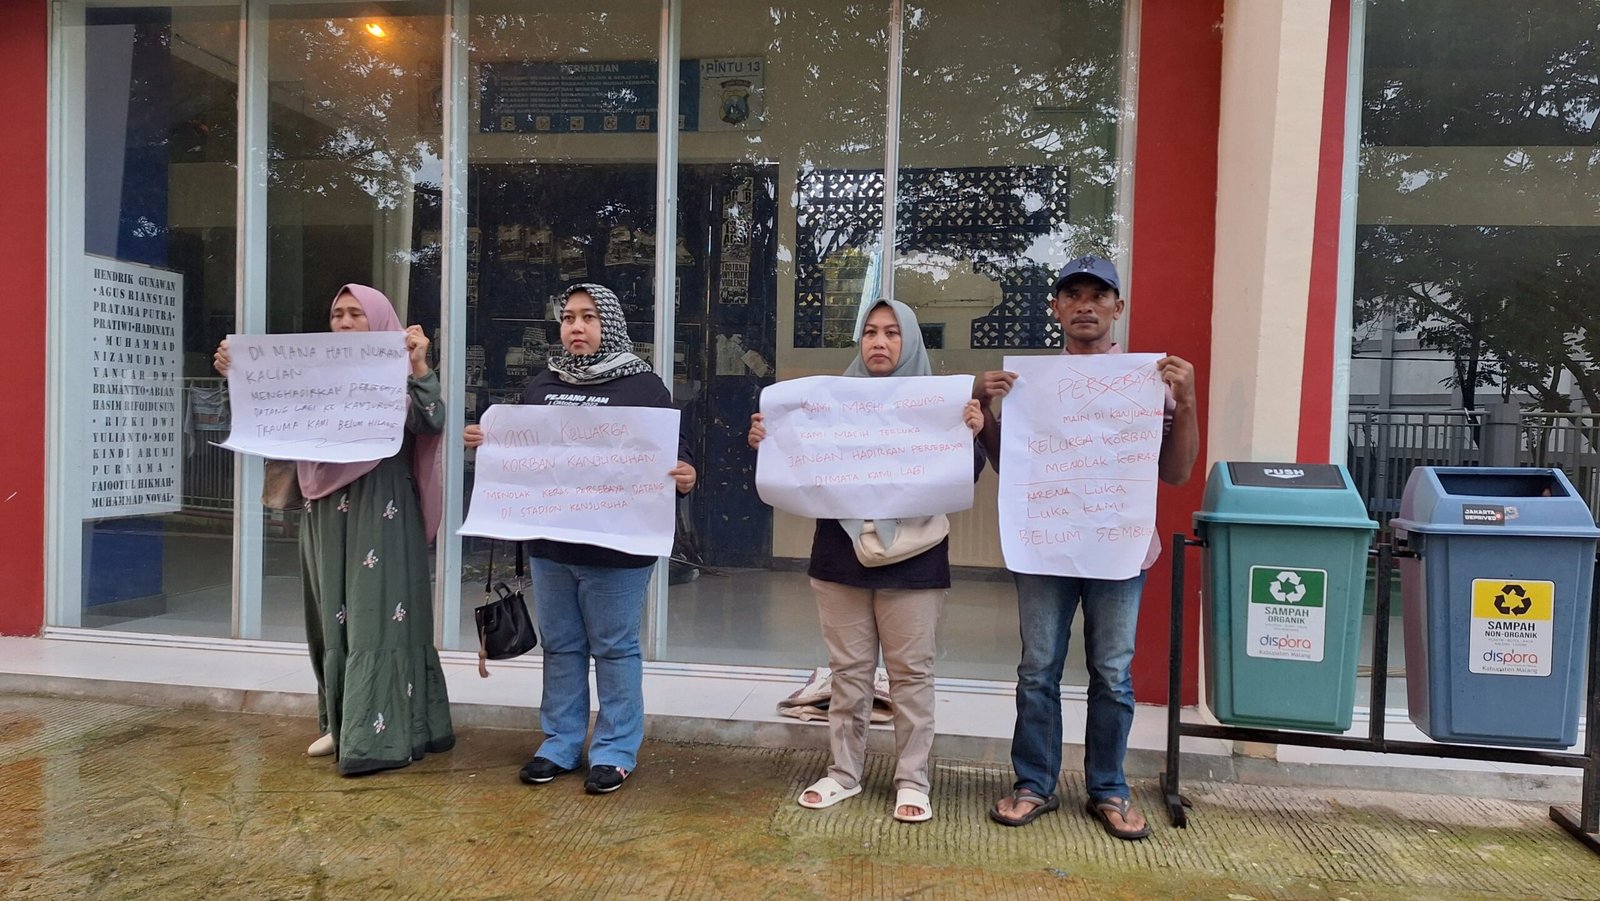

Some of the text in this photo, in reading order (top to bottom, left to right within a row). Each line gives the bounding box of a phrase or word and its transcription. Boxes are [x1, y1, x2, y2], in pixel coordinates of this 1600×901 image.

[560, 64, 619, 73] PERHATIAN
[706, 60, 760, 73] PINTU 13
[94, 268, 175, 291] HENDRIK GUNAWAN
[128, 290, 175, 306] RIANSYAH
[93, 301, 140, 317] PRATAMA
[105, 335, 175, 352] MUHAMMAD
[93, 351, 165, 365] NIZAMUDIN
[249, 346, 262, 361] DI
[273, 345, 316, 360] MANA
[326, 345, 352, 359] HATI
[93, 367, 174, 381] YANUAR DWI
[245, 369, 302, 382] KALIAN
[251, 387, 342, 401] MENGHADIRKAN
[544, 393, 609, 404] PEJUANG HAM
[93, 400, 122, 410] HASIM
[895, 395, 945, 409] TRAUMA
[105, 416, 174, 427] RIZKI DWI
[1063, 413, 1090, 424] MAIN
[1095, 412, 1104, 421] DI
[256, 421, 299, 438] TRAUMA
[307, 419, 329, 430] KAMI
[801, 430, 826, 440] KAMI
[1028, 429, 1158, 455] KELURGA KORBAN
[93, 447, 174, 459] KINDI ARUMI
[788, 452, 844, 469] JANGAN
[853, 447, 906, 462] HADIRKAN
[92, 463, 163, 475] PURNAMA
[502, 454, 656, 473] KORBAN KANJURUHAN
[1046, 452, 1158, 474] MENOLAK KERAS
[868, 470, 892, 480] KAMI
[1263, 468, 1305, 476] PUSH
[631, 482, 665, 495] DATANG
[1027, 484, 1126, 501] KARENA LUKA
[91, 495, 143, 508] MUHAMMAD
[501, 507, 512, 520] DI
[520, 504, 562, 518] STADION
[1027, 502, 1125, 520] LUKA KAMI
[1019, 529, 1081, 546] BELUM
[1264, 606, 1310, 617] SAMPAH
[1268, 616, 1305, 624] ORGANIK
[1487, 621, 1535, 631] SAMPAH
[1260, 634, 1311, 649] dispora
[1484, 631, 1538, 639] NON-ORGANIK
[1259, 650, 1290, 658] Kabupaten
[1483, 649, 1538, 664] dispora
